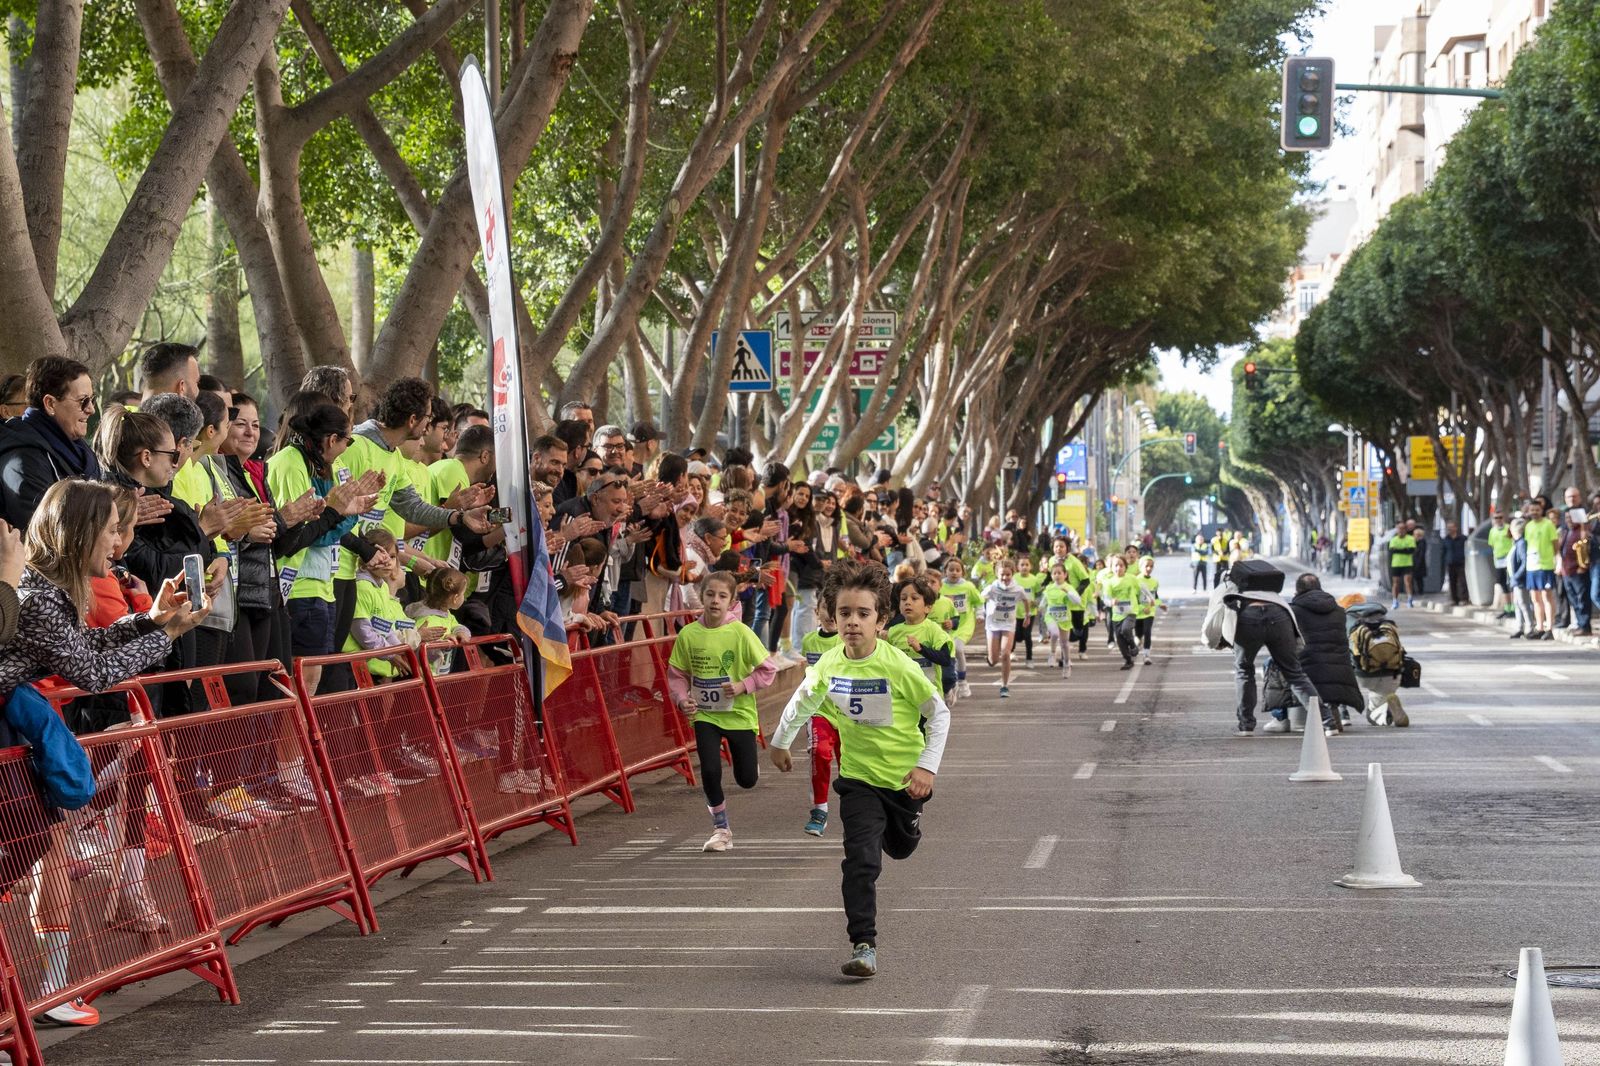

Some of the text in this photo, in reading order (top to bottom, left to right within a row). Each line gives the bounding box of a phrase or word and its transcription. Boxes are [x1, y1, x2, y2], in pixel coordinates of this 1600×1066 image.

[862, 316, 892, 324] ciones
[812, 327, 833, 335] N-34
[821, 428, 835, 438] de
[413, 538, 426, 552] 85
[331, 548, 340, 562] 1
[701, 690, 720, 703] 30
[849, 697, 864, 715] 5
